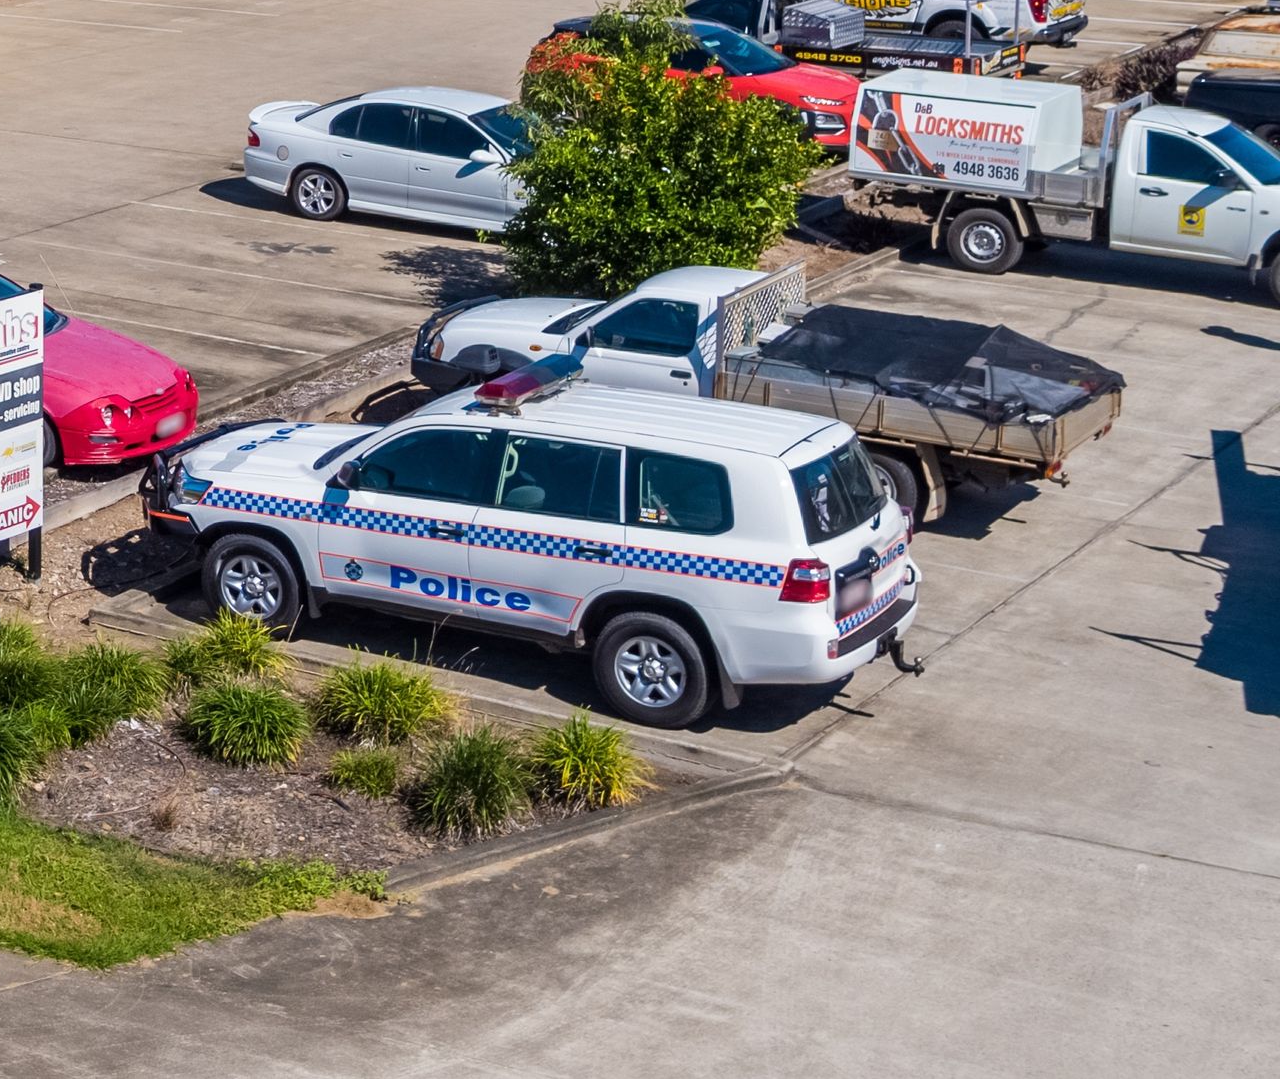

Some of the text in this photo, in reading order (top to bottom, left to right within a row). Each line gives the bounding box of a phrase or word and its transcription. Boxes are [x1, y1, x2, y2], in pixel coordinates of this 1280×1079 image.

[795, 52, 863, 63] 4948 3700
[872, 55, 938, 69] angelsigns.net.au
[914, 102, 933, 114] D&B
[914, 114, 1024, 145] LOCKSMITHS
[953, 160, 1020, 182] 4948 3636
[13, 375, 40, 398] shop
[4, 400, 40, 422] servicing
[5, 467, 30, 484] PEDDERS
[877, 542, 905, 569] olice
[390, 565, 532, 611] Police
